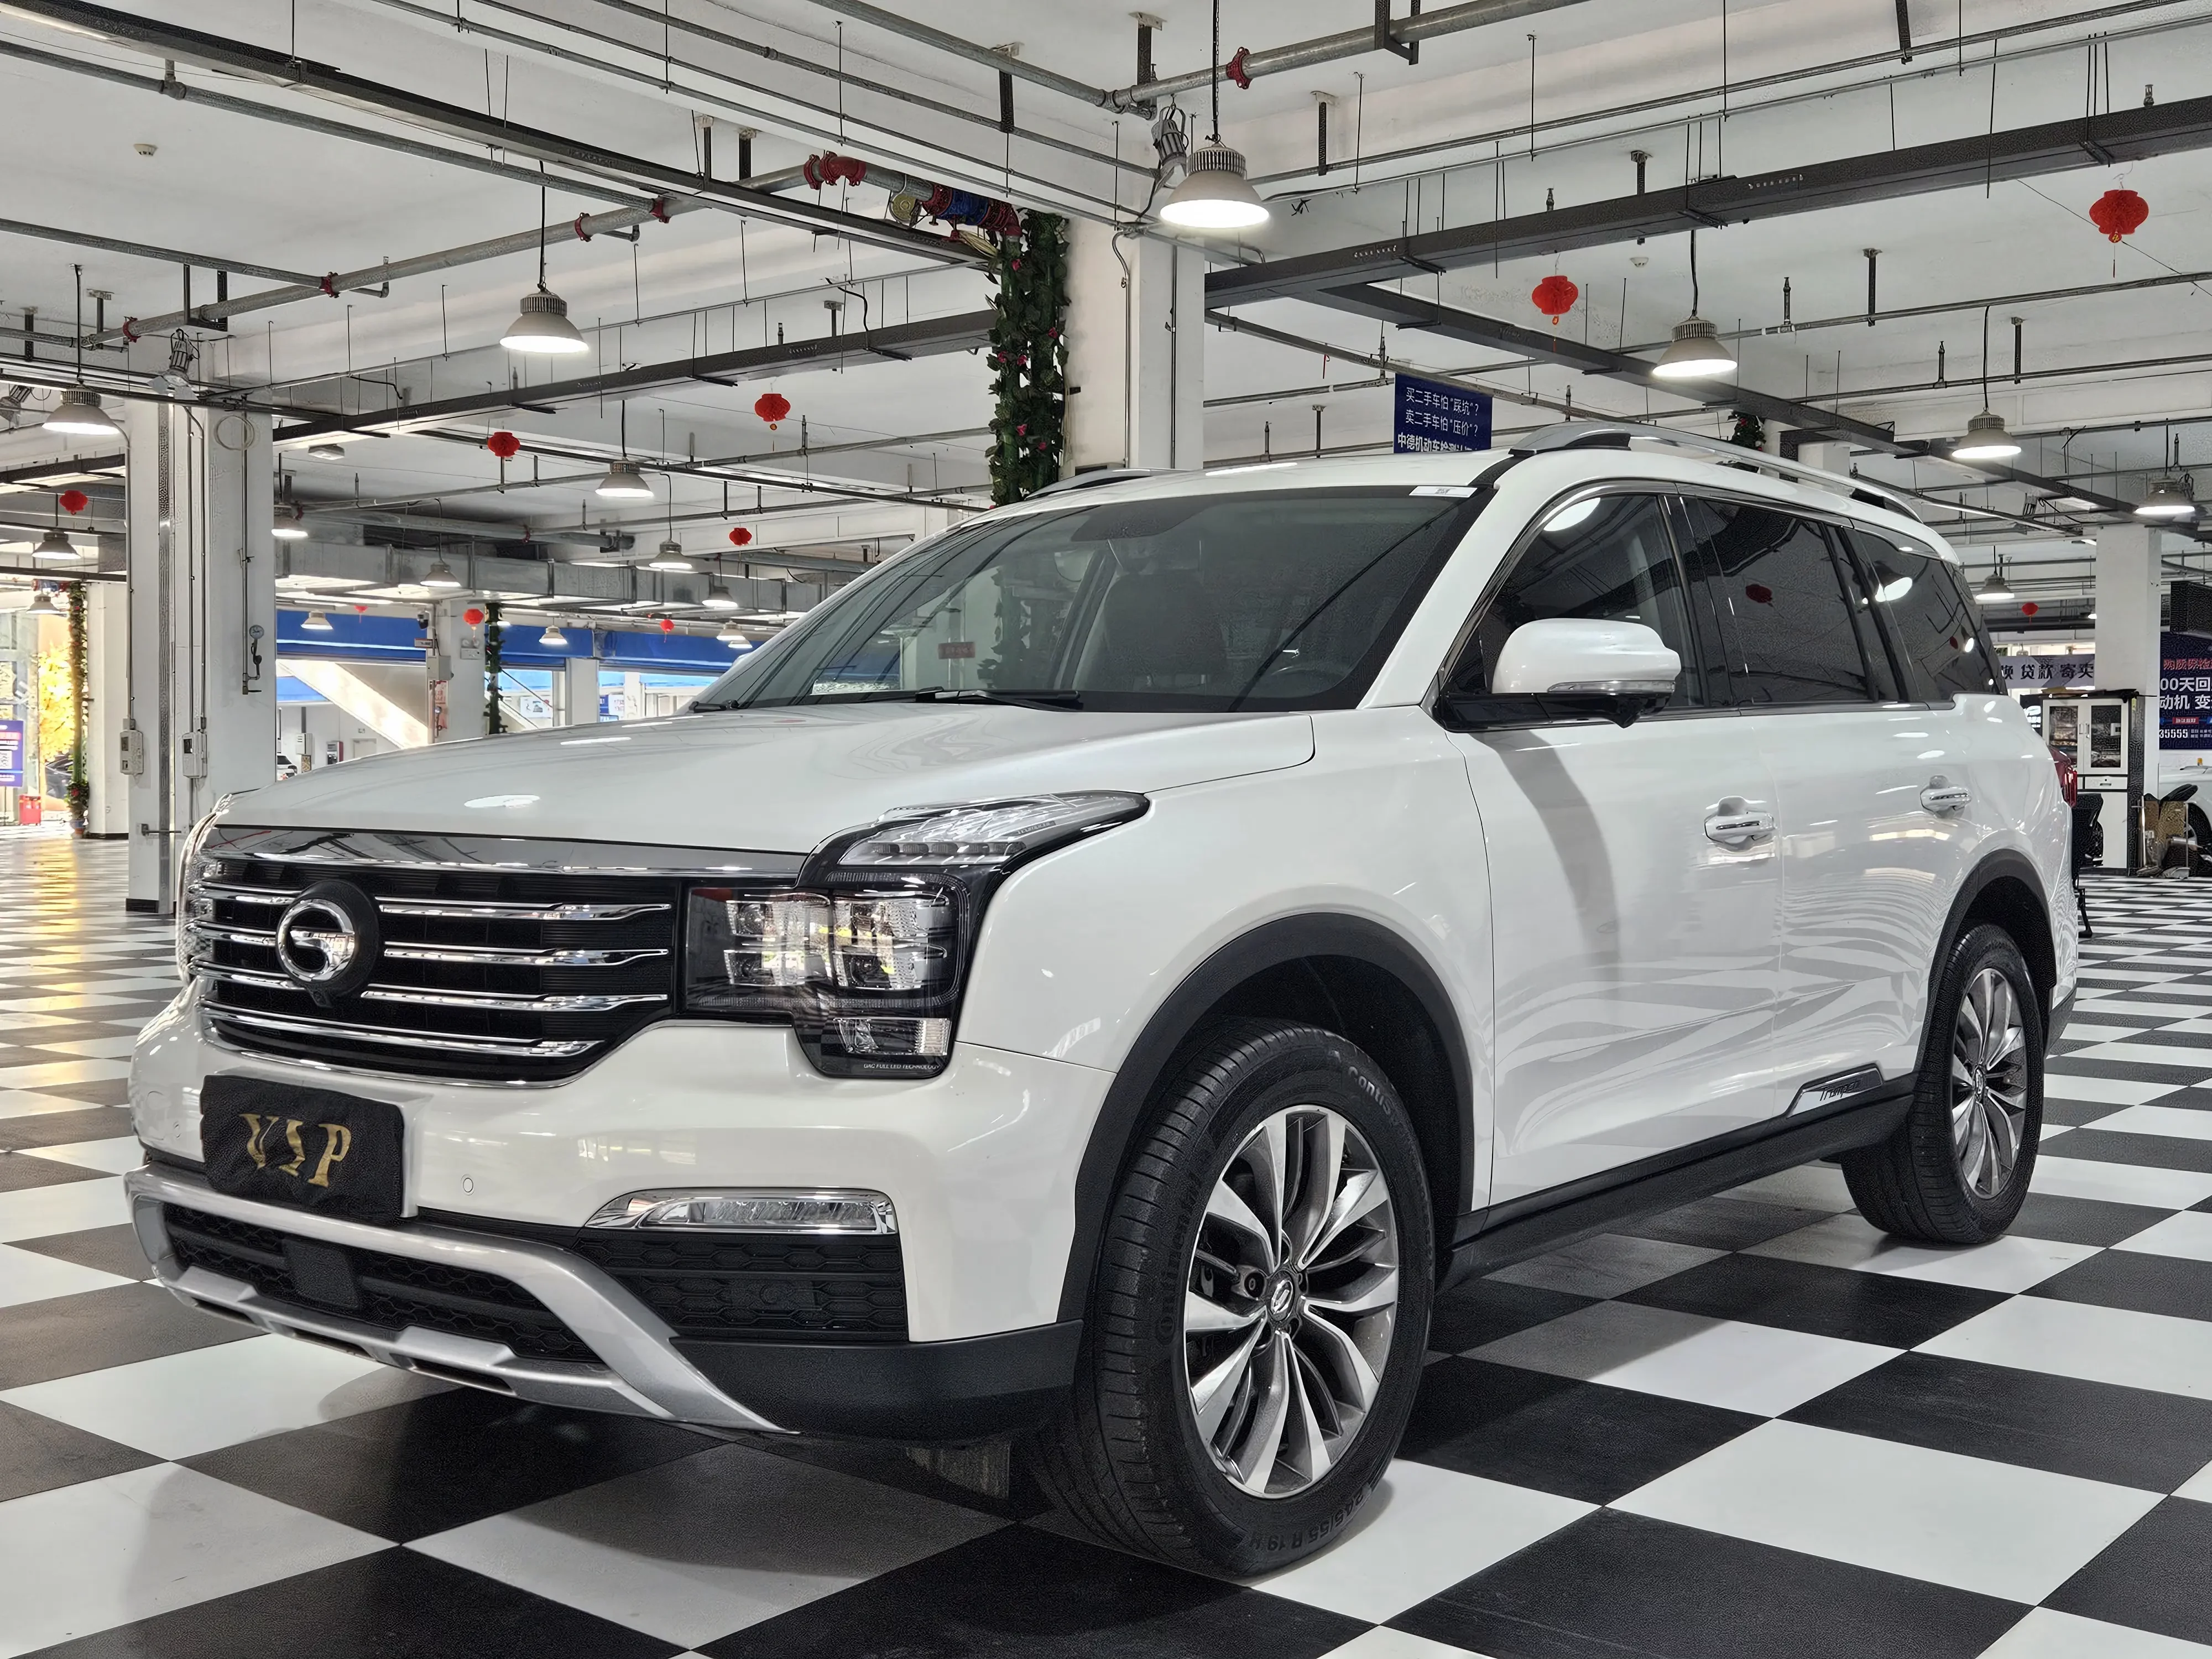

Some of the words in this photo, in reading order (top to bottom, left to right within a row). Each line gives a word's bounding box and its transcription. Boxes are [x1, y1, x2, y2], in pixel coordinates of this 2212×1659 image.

[2020, 664, 2053, 680] 贷款
[2060, 663, 2094, 679] 寄卖
[2160, 677, 2212, 692] 00天回
[2194, 694, 2212, 710] 变
[238, 1113, 352, 1188] VIP
